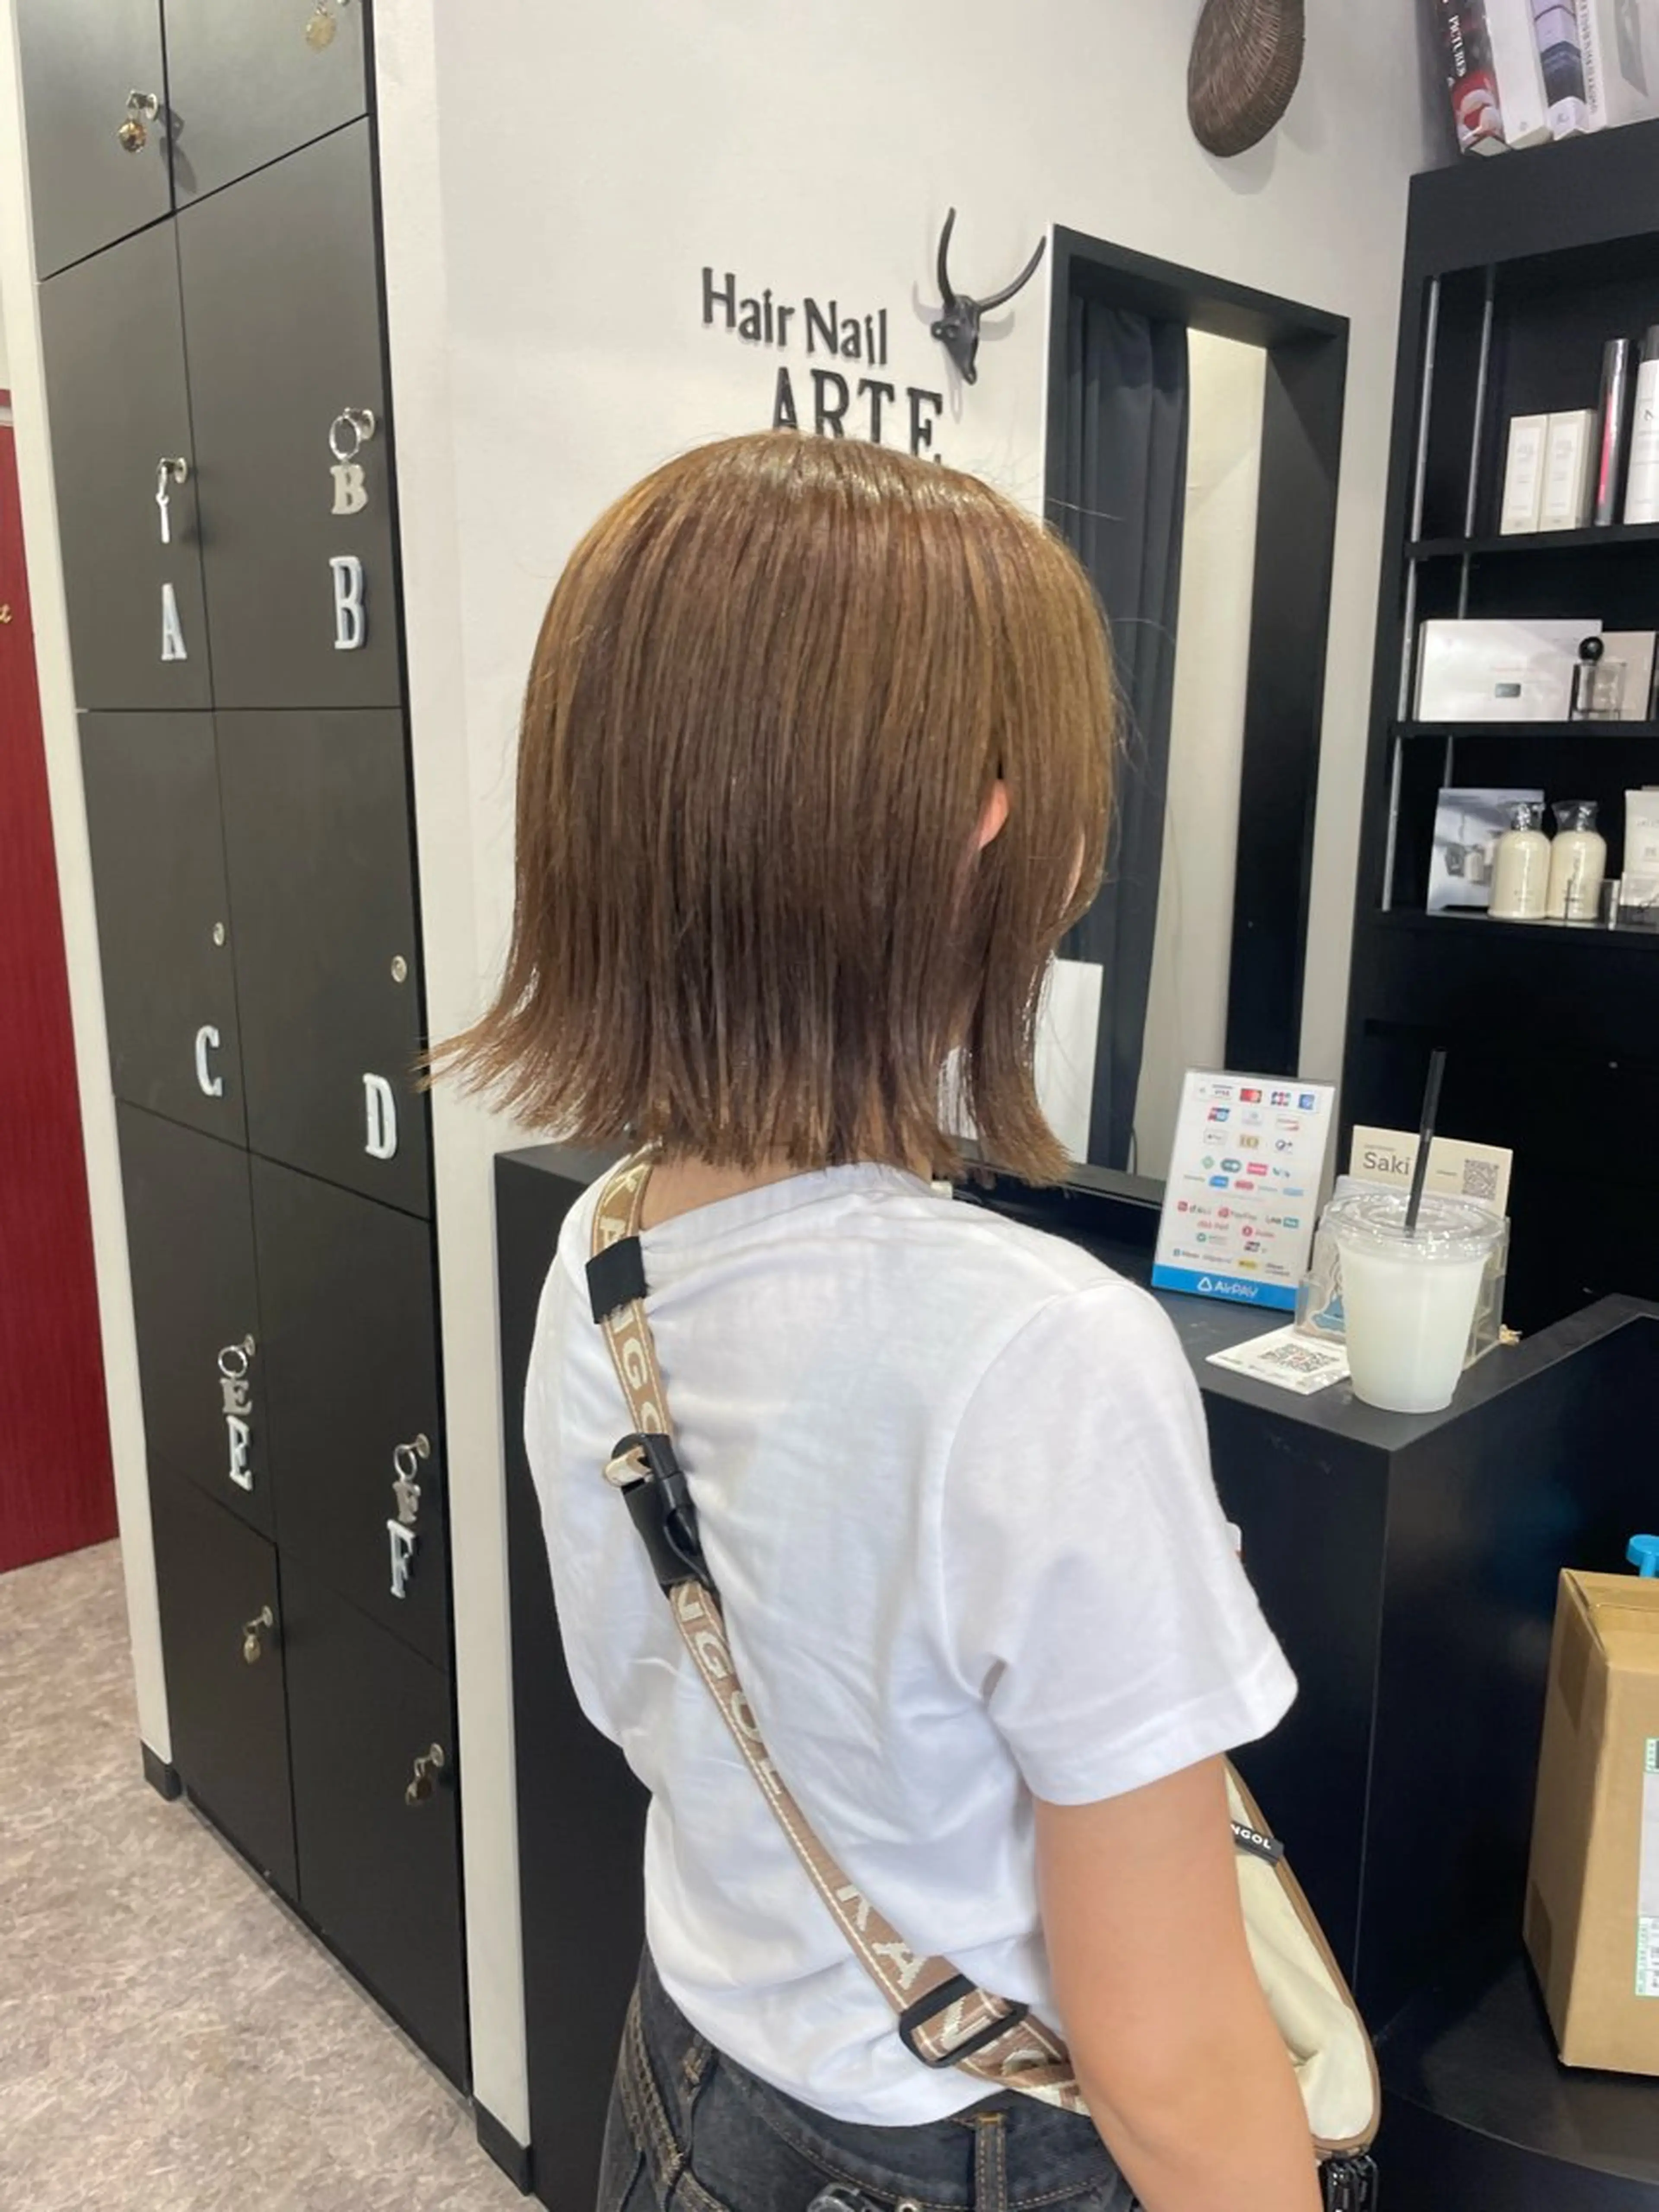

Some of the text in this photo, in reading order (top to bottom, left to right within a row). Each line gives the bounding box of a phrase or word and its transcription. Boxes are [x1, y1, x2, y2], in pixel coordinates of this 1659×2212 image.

[702, 267, 887, 365] Hair Nail
[772, 366, 943, 464] ARTE
[161, 582, 188, 661] A
[329, 556, 365, 649] B
[195, 1025, 222, 1096] C
[362, 1072, 398, 1160] D
[1363, 1151, 1411, 1176] Saki
[226, 1415, 253, 1491] E
[387, 1519, 415, 1599] F
[1230, 1823, 1271, 1850] NGOL
